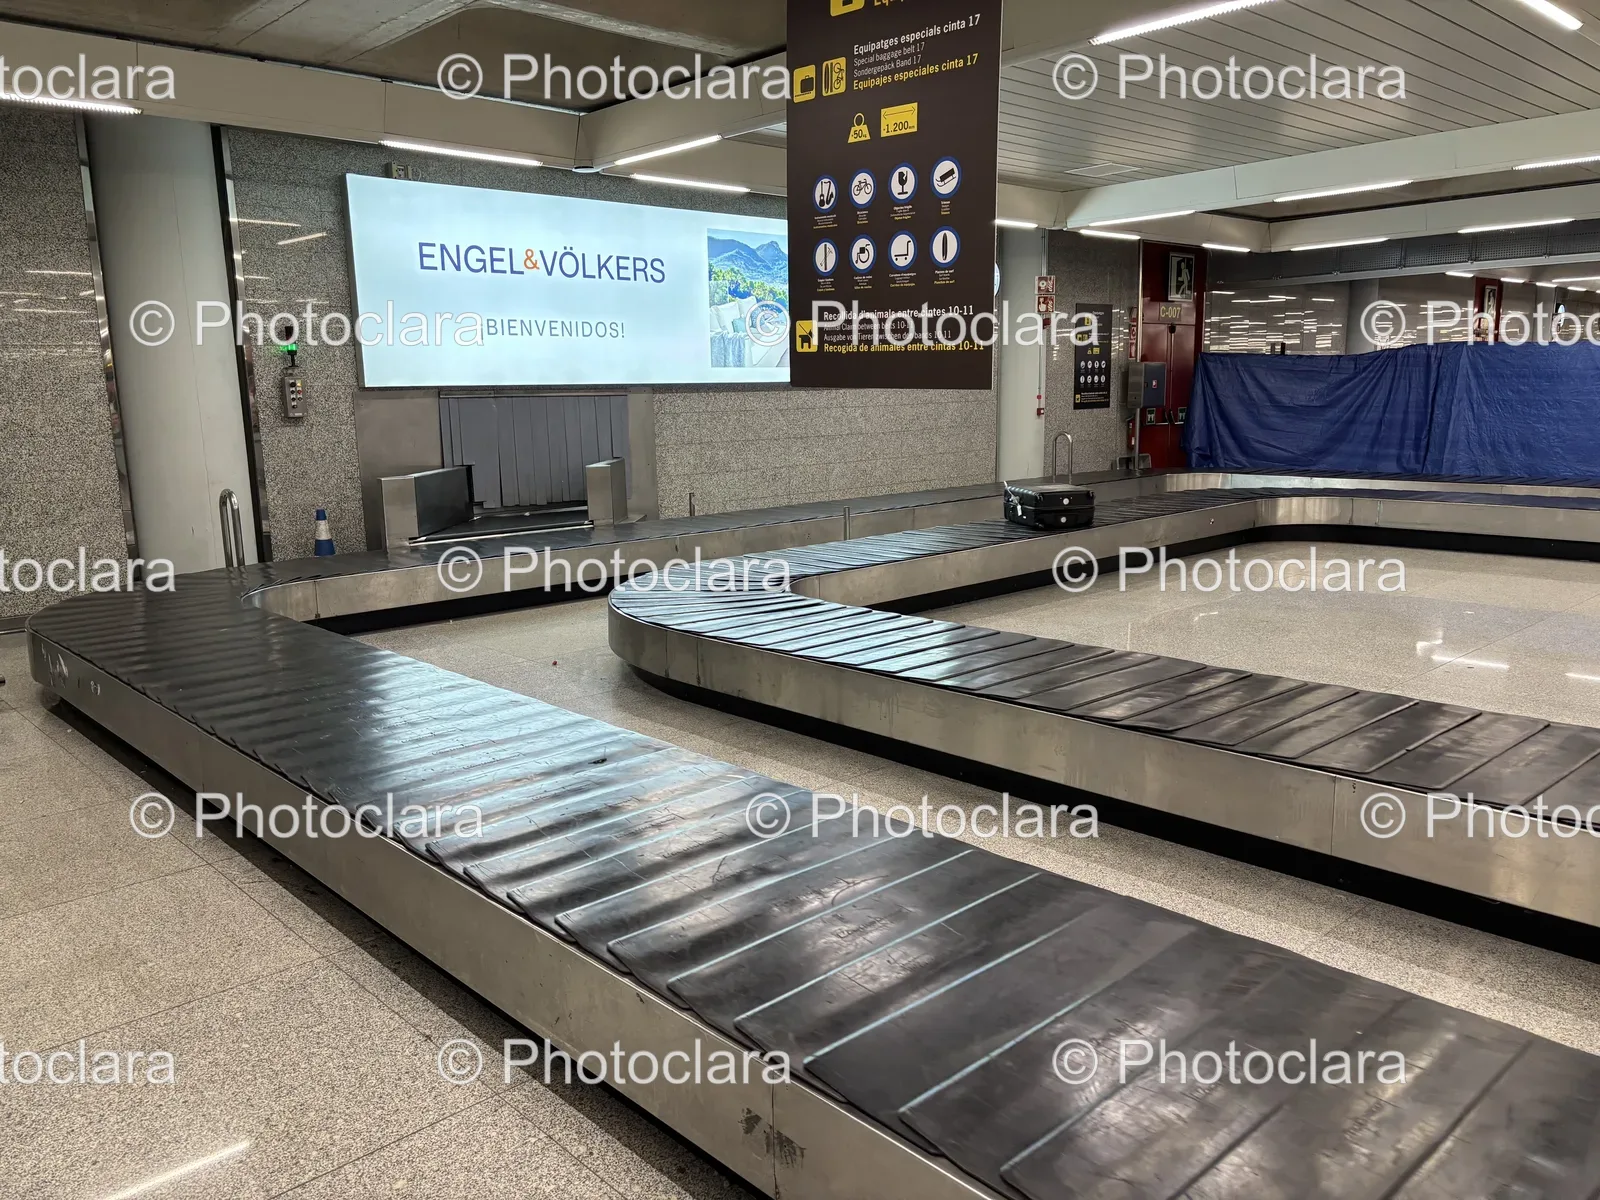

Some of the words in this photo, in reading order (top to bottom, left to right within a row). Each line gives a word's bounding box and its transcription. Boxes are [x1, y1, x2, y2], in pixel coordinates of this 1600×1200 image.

[854, 37, 898, 55] Equipatges
[901, 25, 941, 43] especials
[943, 20, 966, 33] cinta
[968, 14, 980, 27] 17
[854, 54, 874, 67] Special
[875, 49, 901, 62] baggage
[903, 45, 915, 55] belt
[916, 42, 925, 52] 17
[854, 63, 894, 77] Sondergepäck
[896, 57, 911, 68] Band
[913, 55, 921, 64] 17
[853, 74, 892, 91] Equipajes
[894, 64, 939, 81] especiales
[941, 59, 963, 71] cinta
[966, 53, 978, 66] 17
[418, 241, 666, 284] ENGEL&VÖLKERS
[897, 308, 918, 318] entre
[920, 307, 946, 317] cintes
[948, 305, 974, 316] 10-11
[1160, 305, 1181, 319] C-007
[824, 343, 858, 354] Recogida
[860, 343, 869, 352] de
[870, 342, 905, 352] animales
[907, 342, 929, 351] entre
[931, 341, 956, 351] cintas
[959, 340, 984, 351] 10-11
